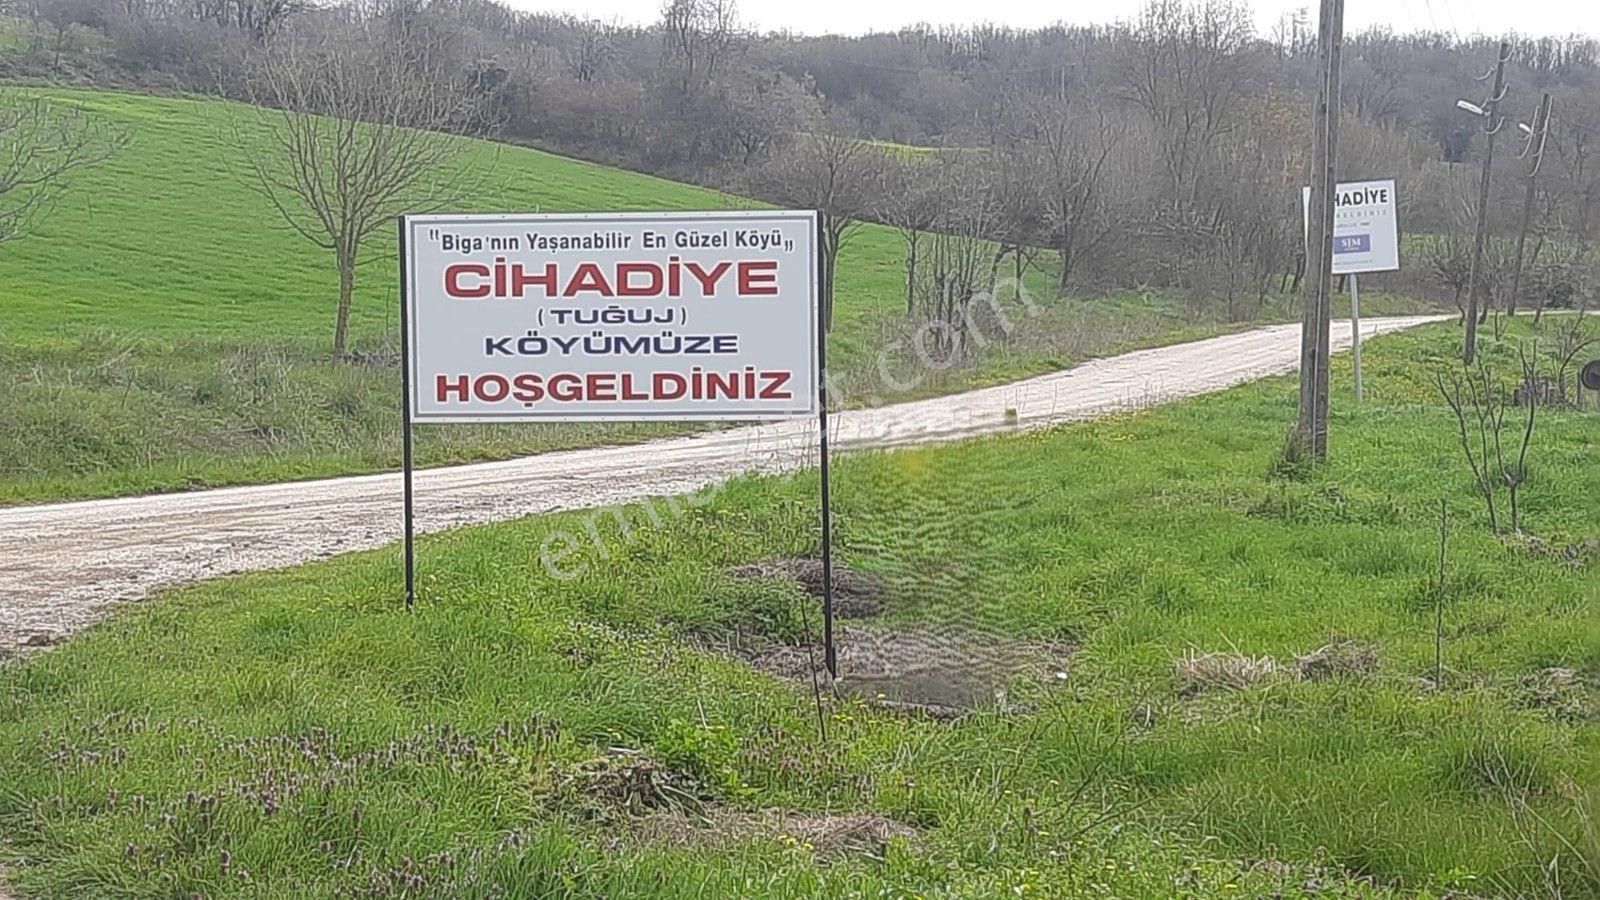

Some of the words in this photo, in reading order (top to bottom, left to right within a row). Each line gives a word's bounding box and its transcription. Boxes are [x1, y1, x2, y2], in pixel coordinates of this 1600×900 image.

[1334, 187, 1388, 206] HADİYE
[526, 232, 631, 253] Yaşanabilir
[643, 232, 666, 248] En
[675, 231, 727, 248] Güzel
[445, 256, 778, 298] CİHADİYE
[485, 331, 738, 355] KÖYÜMÜZE
[436, 366, 792, 408] HOŞGELDİNİZ
